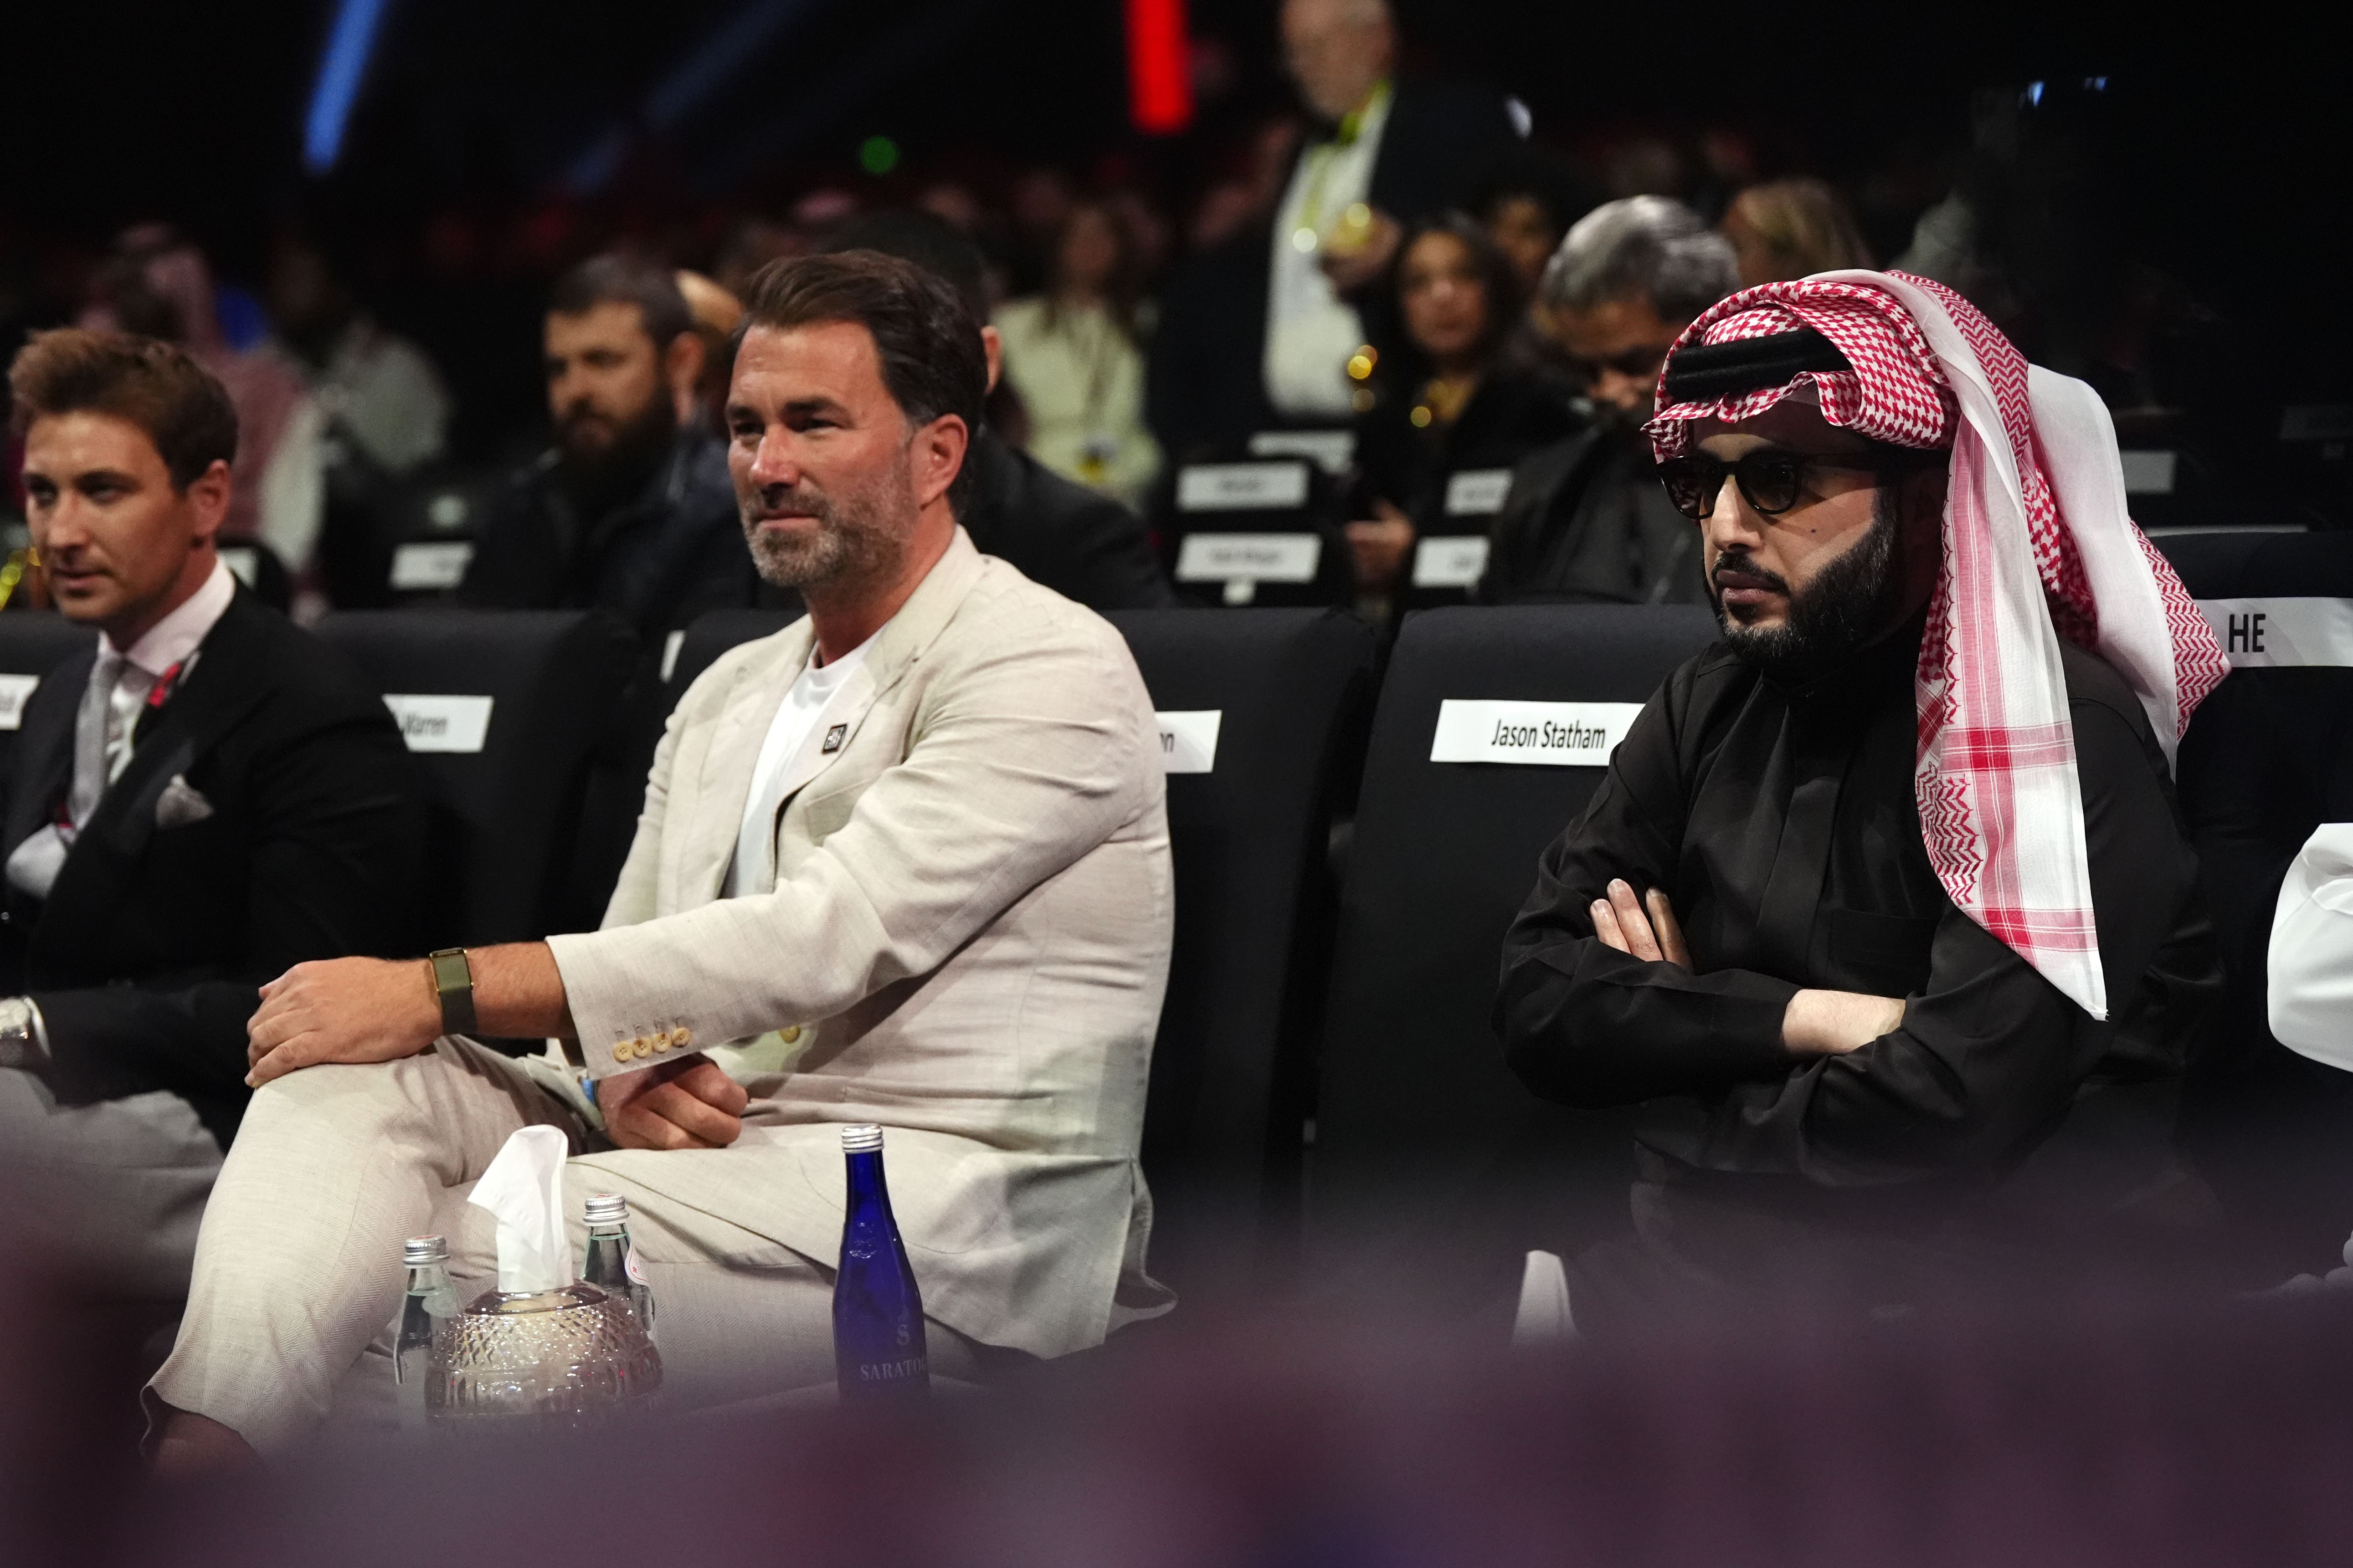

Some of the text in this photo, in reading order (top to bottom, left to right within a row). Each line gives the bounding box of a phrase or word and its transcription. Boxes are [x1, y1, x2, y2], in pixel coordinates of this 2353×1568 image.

[2229, 614, 2266, 653] HE
[1491, 719, 1606, 749] Jason Statham
